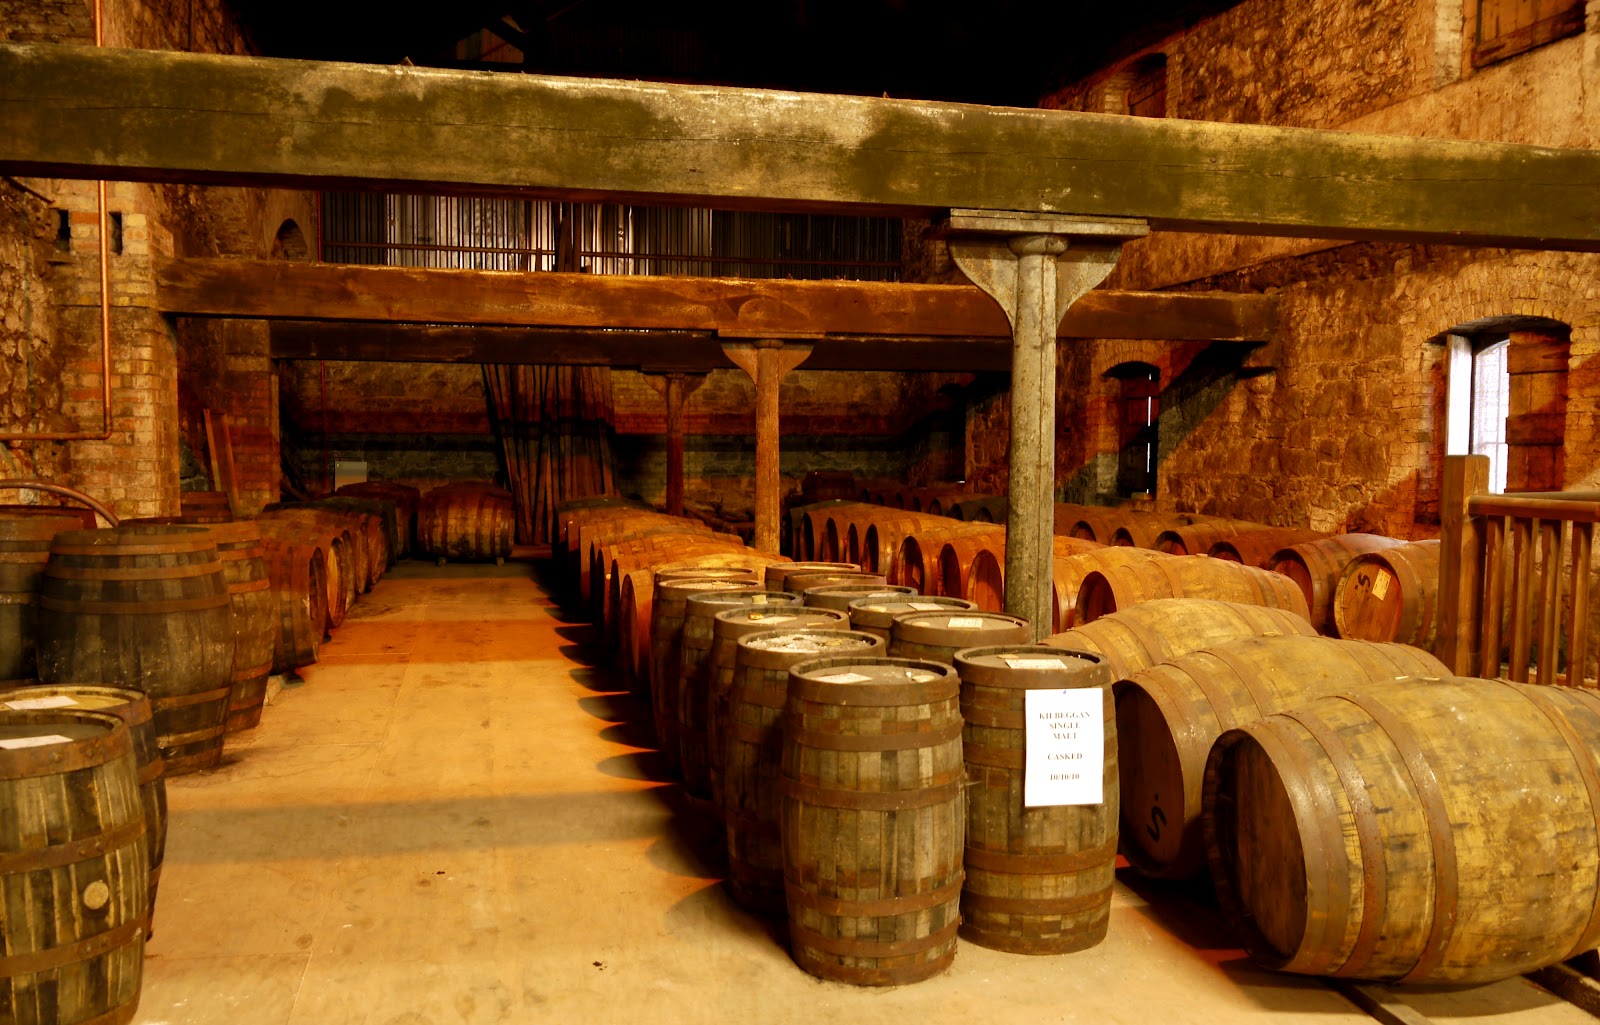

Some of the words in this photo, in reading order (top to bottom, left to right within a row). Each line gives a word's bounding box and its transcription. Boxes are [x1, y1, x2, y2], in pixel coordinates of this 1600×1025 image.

[1039, 711, 1091, 720] KILBEGGAN
[1049, 722, 1081, 730] SINGLE
[1053, 732, 1078, 740] MALT
[1047, 752, 1084, 761] CASKED
[1050, 773, 1081, 781] 10/10/10
